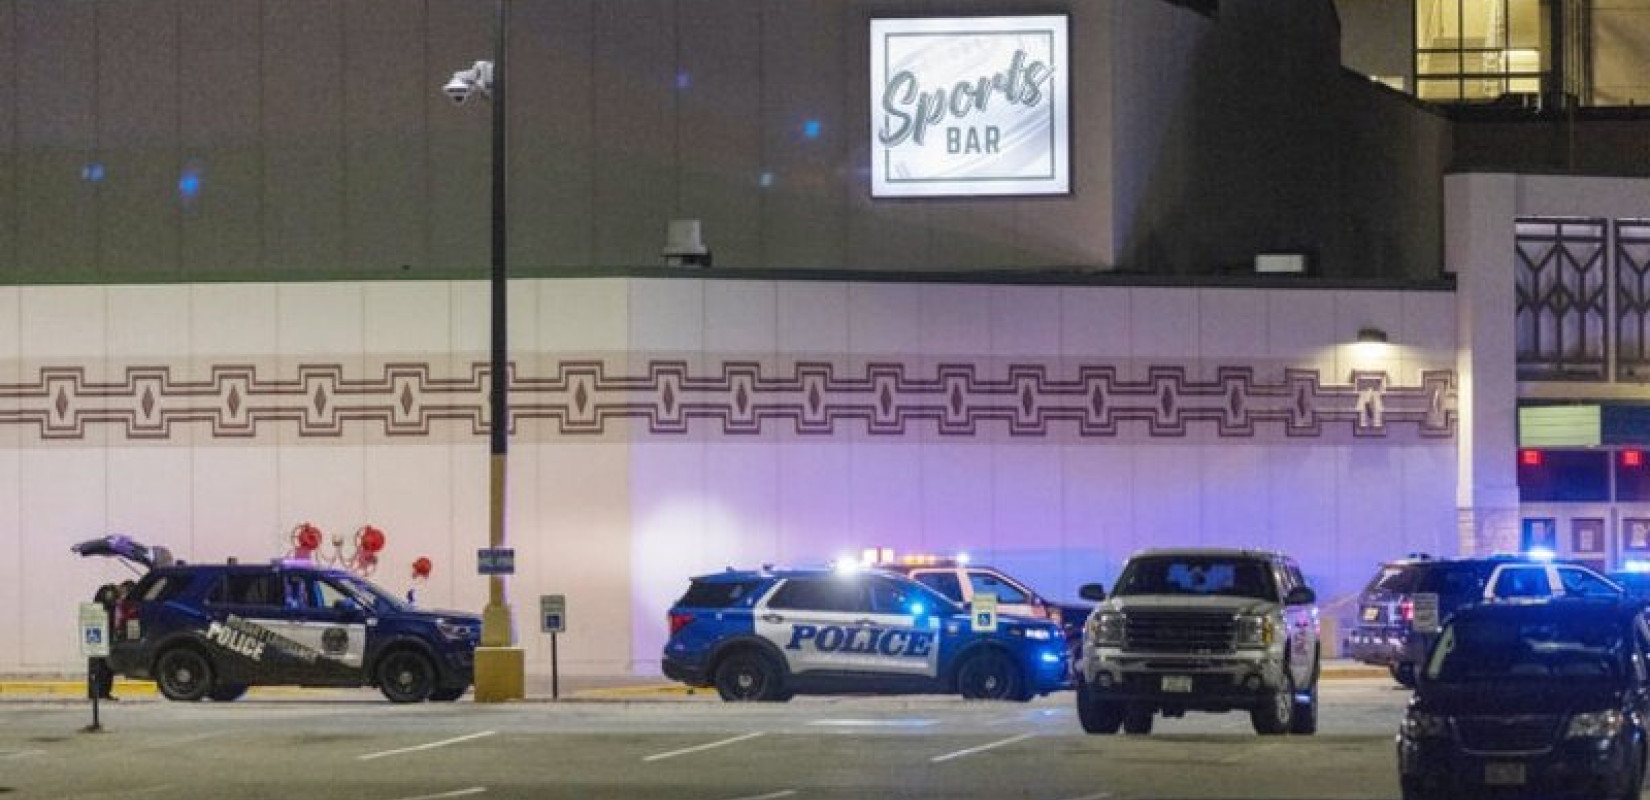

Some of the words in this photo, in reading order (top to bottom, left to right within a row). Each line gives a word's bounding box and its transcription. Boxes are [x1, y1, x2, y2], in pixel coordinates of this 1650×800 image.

[879, 49, 1055, 147] Sports
[947, 126, 1001, 154] BAR
[206, 621, 265, 661] POLICE
[785, 625, 936, 655] POLICE
